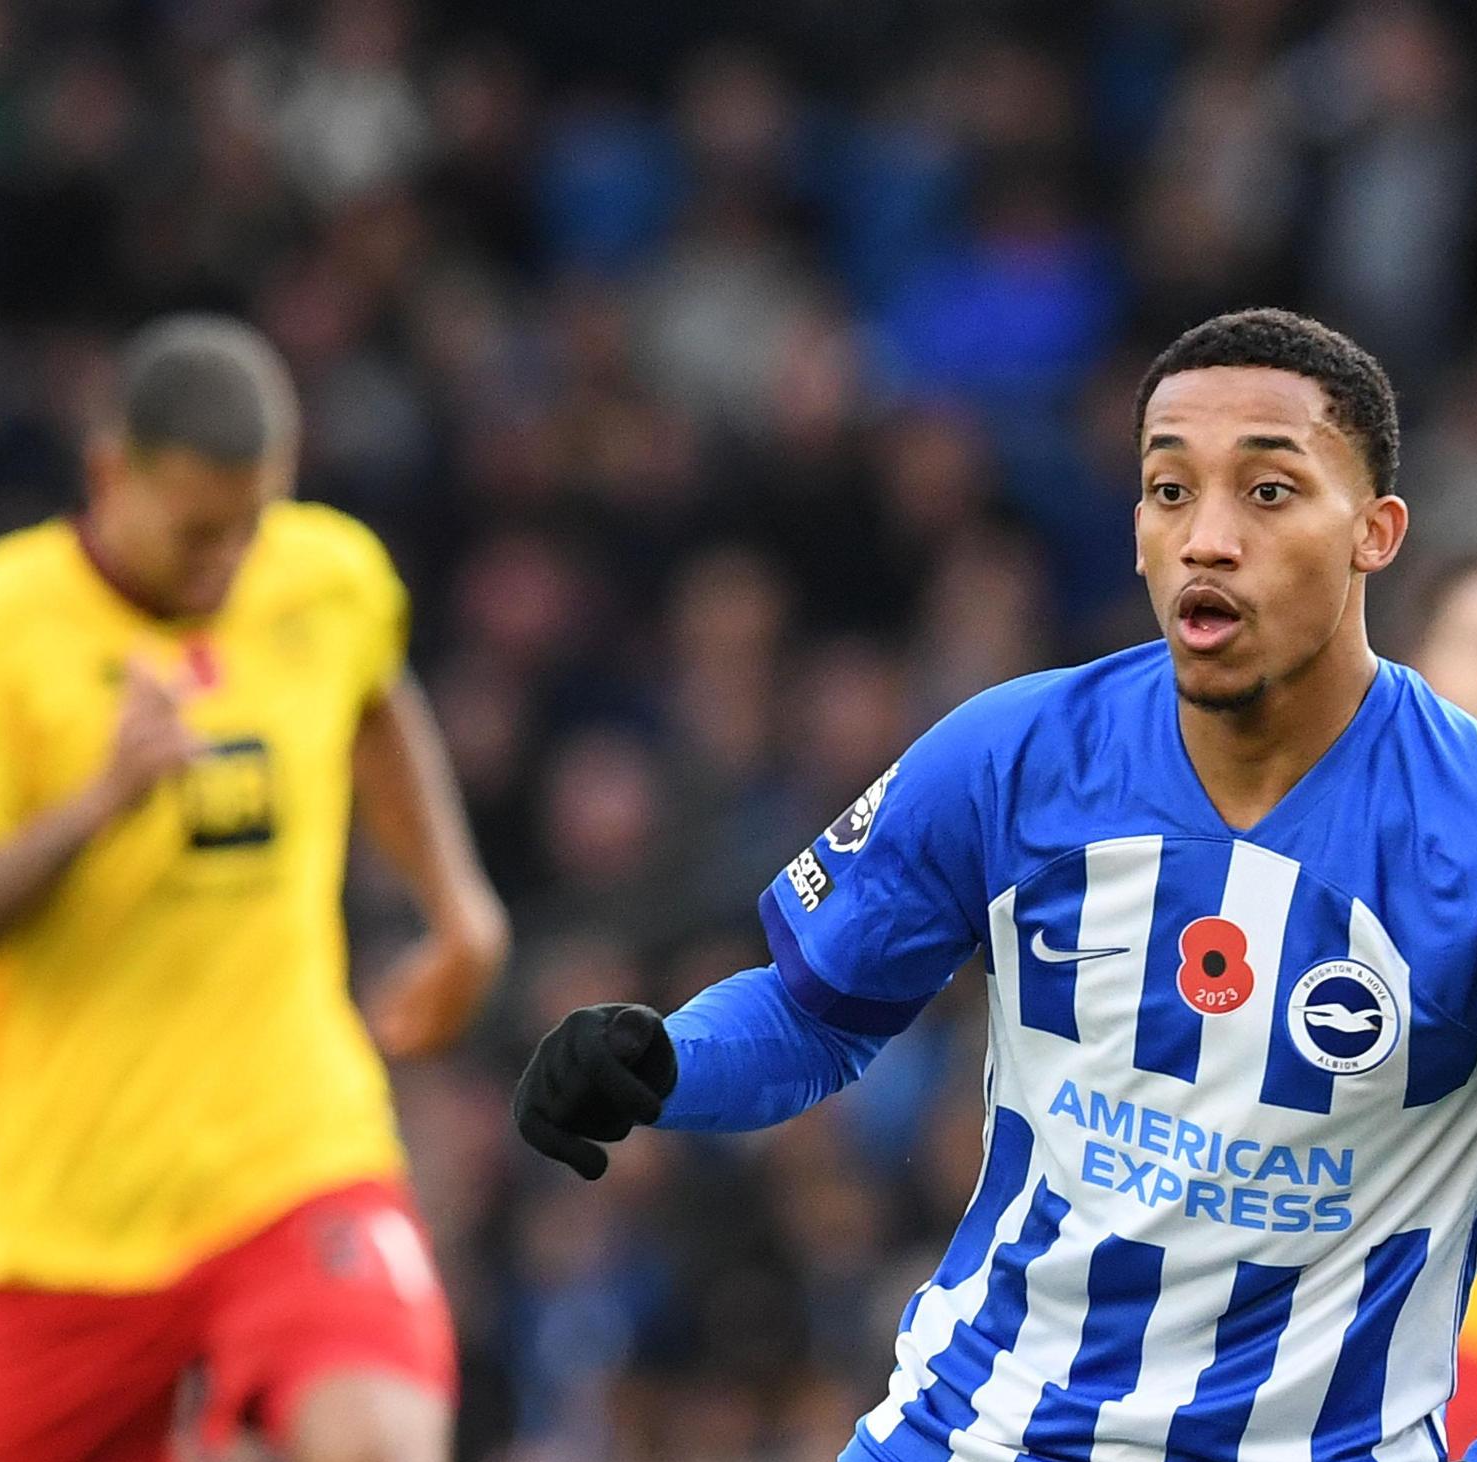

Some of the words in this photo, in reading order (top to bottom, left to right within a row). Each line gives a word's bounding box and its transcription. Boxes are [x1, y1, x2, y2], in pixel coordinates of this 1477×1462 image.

[1195, 987, 1239, 1007] 2023
[1302, 964, 1352, 989] BRIGHTON
[1366, 976, 1388, 1001] HOVE
[1317, 1056, 1359, 1070] ALBION
[1048, 1079, 1355, 1187] AMERICAN
[1081, 1140, 1354, 1233] EXPRESS
